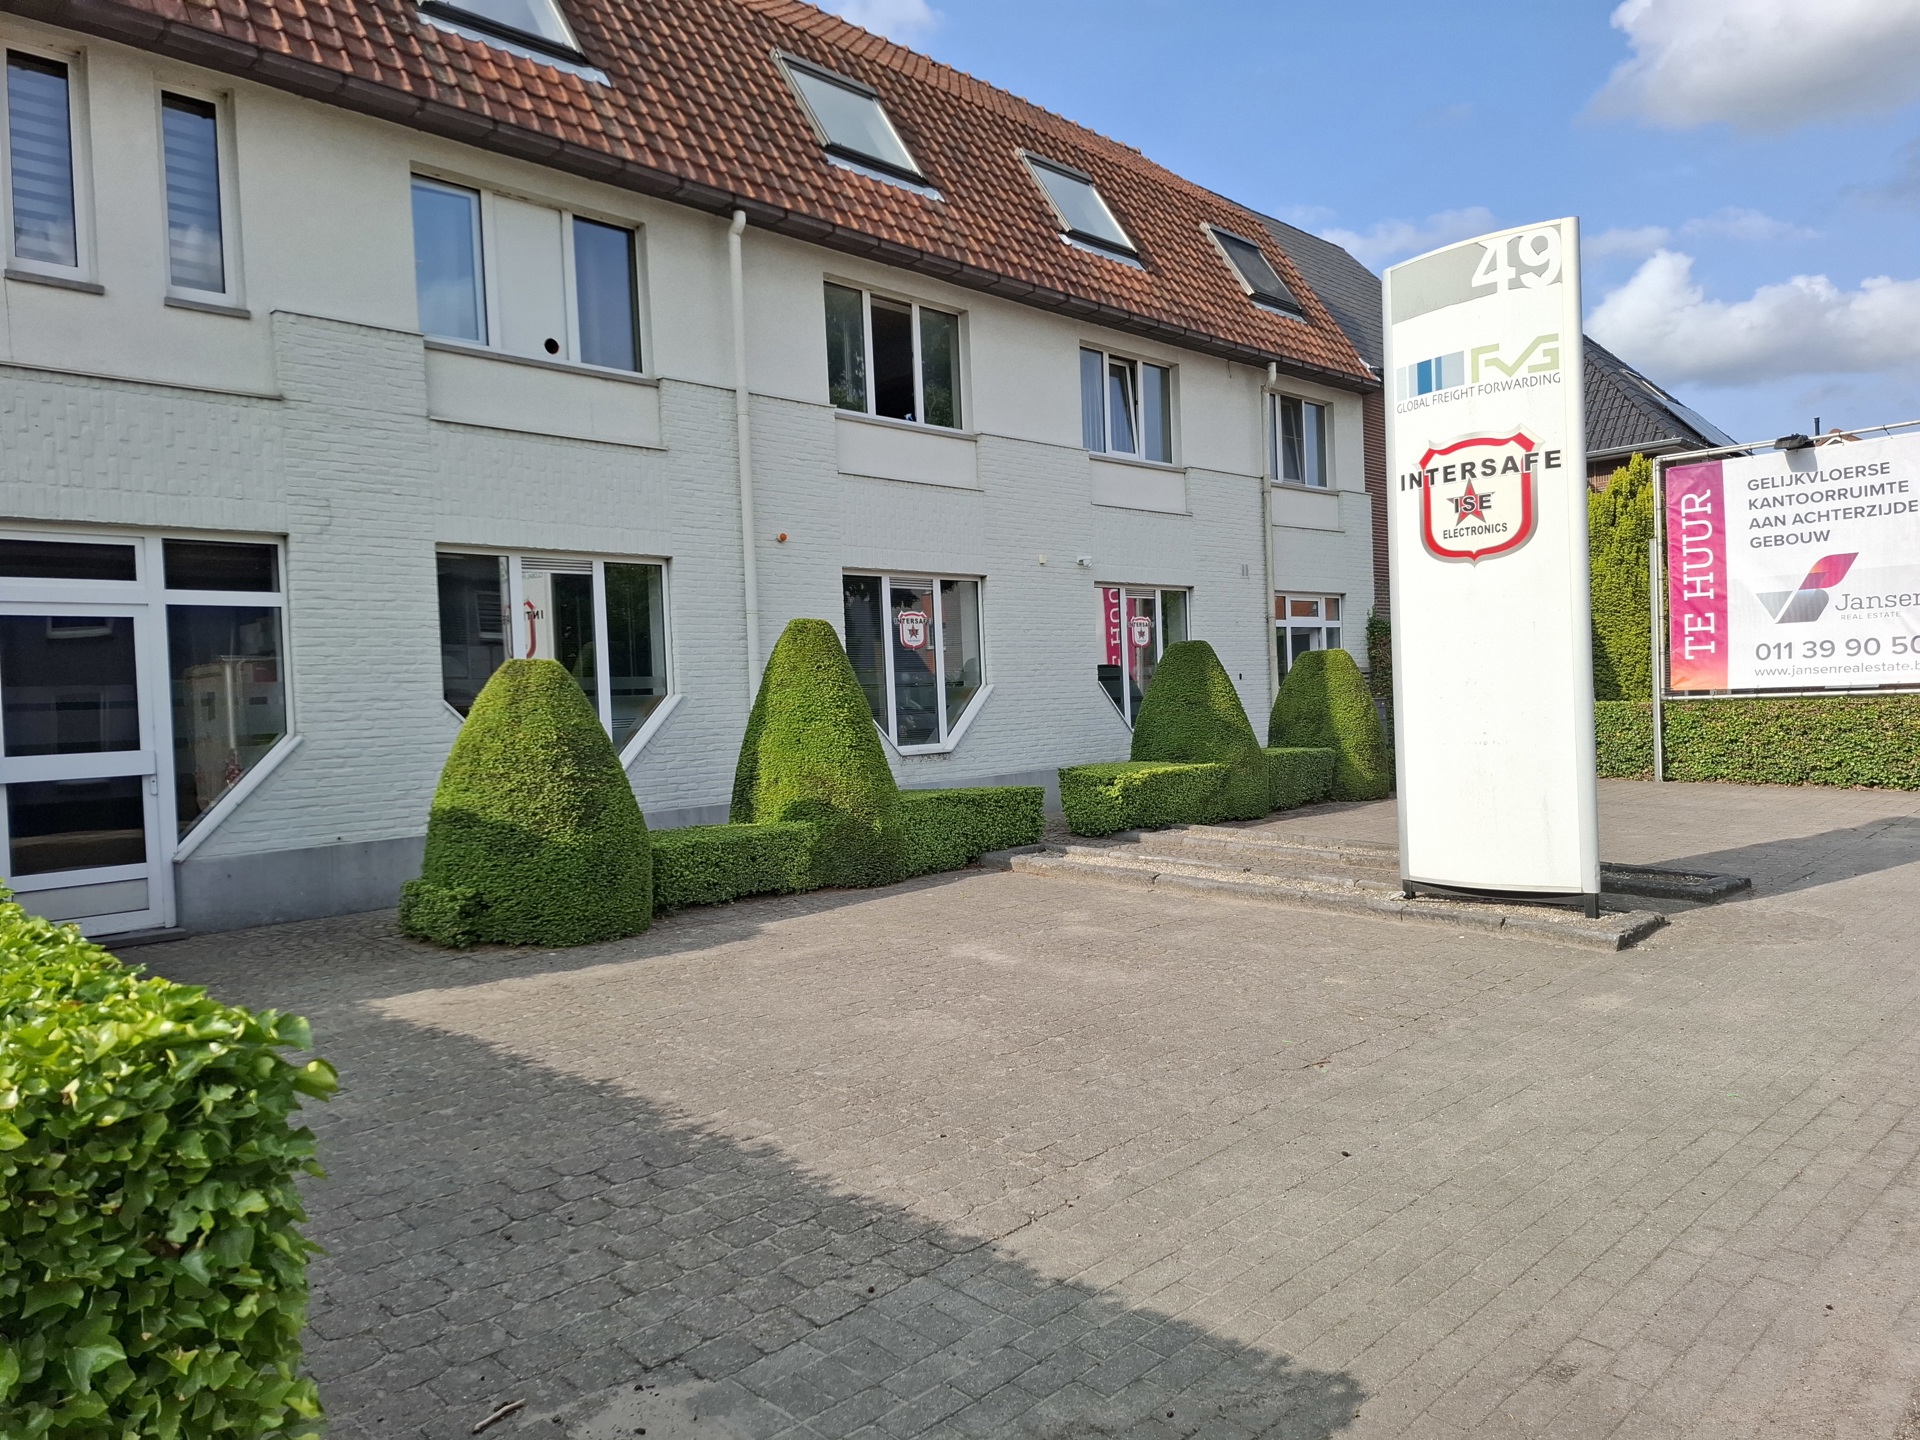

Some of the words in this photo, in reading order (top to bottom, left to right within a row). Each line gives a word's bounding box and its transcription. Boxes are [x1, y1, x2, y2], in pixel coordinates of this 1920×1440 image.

[1471, 225, 1562, 293] 49
[1396, 398, 1430, 414] GLOBAL
[1432, 386, 1475, 406] FREIGHT
[1478, 372, 1561, 396] FORWARDING
[1400, 450, 1562, 492] INTERSAFE
[1747, 461, 1890, 491] GELIJKVLOERSE
[1454, 493, 1492, 514] ISE
[1748, 480, 1909, 510] KANTOORRUIMTE
[1749, 514, 1786, 530] AAN
[1792, 499, 1919, 525] ACHTERZIJDE
[1443, 522, 1508, 540] ELECTRONICS
[1681, 489, 1714, 601] HUUR
[1750, 529, 1830, 549] GEBOUW
[1841, 613, 1863, 621] REAL
[1867, 611, 1901, 619] ESTATE
[1684, 612, 1715, 660] TE
[1755, 641, 1793, 661] 011
[1802, 639, 1836, 659] 39
[1845, 637, 1881, 657] 90
